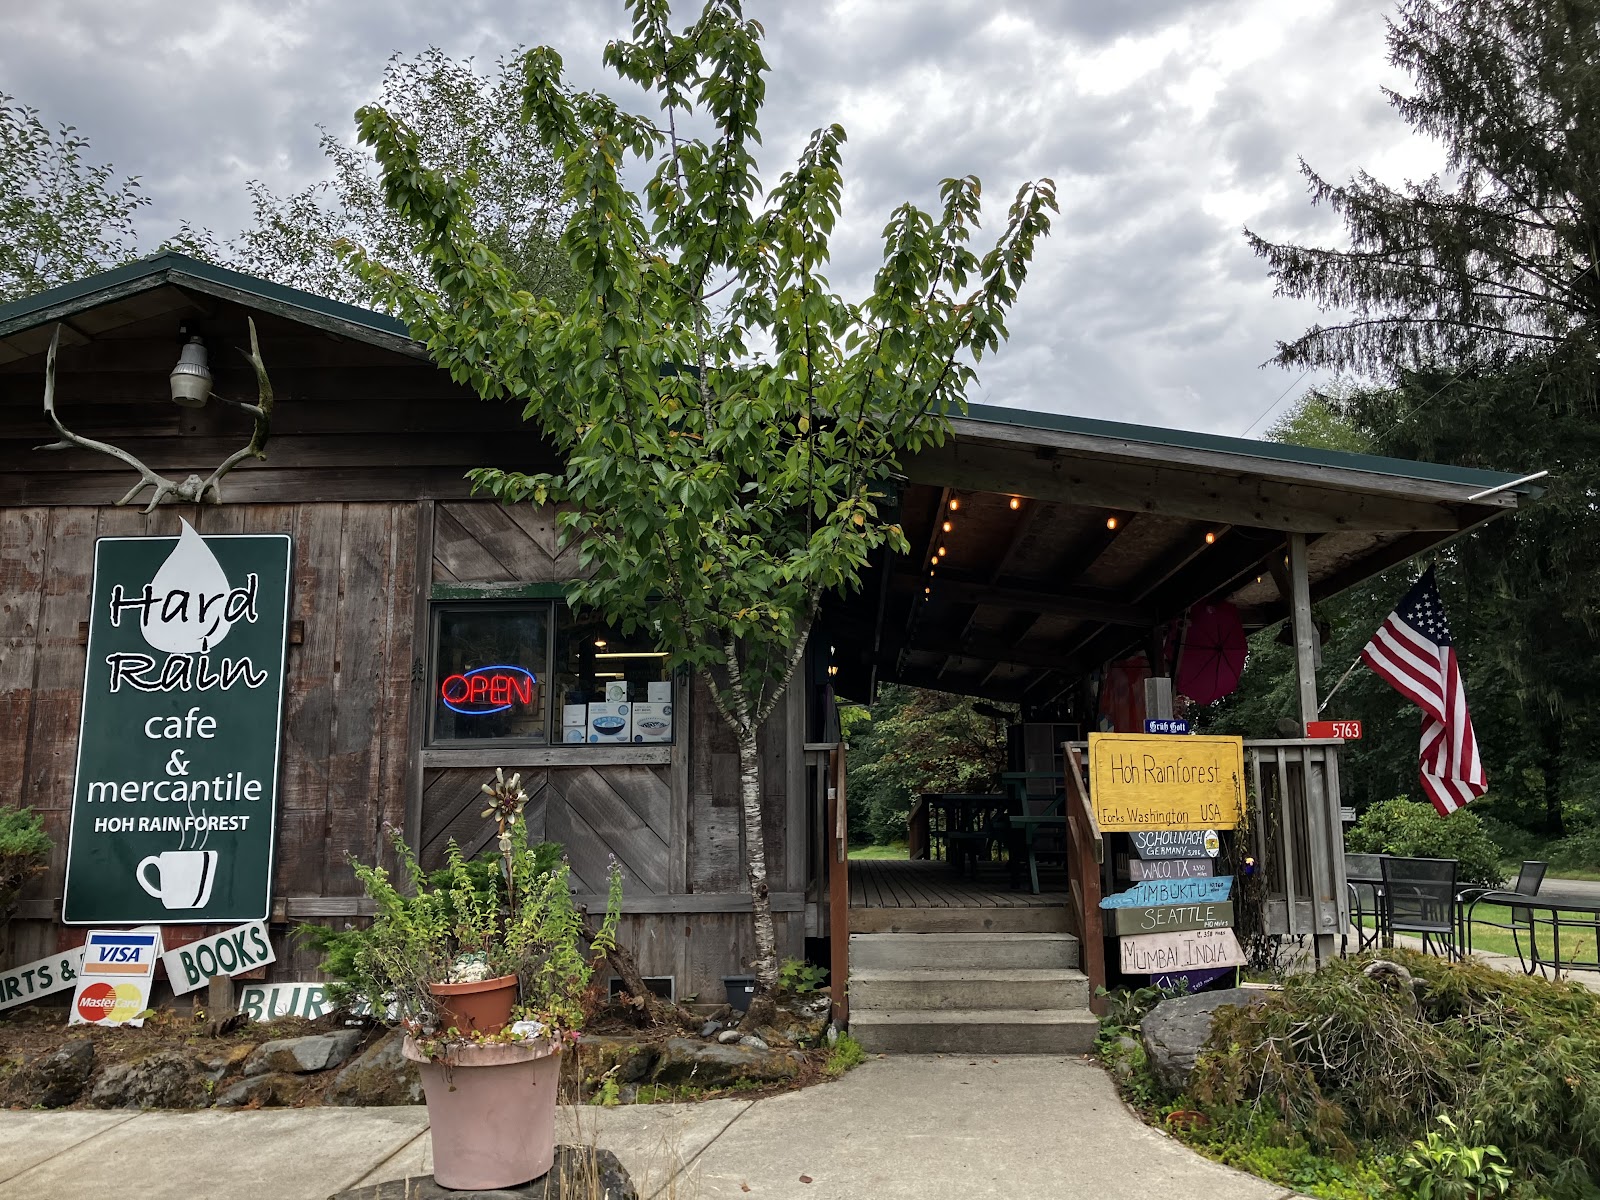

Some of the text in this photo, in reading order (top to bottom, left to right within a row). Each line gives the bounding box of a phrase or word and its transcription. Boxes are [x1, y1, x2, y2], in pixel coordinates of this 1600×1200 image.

[110, 573, 258, 627] Hard
[106, 634, 268, 693] Rain
[442, 674, 532, 704] OPEN
[144, 706, 217, 739] cafe
[1332, 723, 1359, 738] 5763
[165, 749, 190, 776] &
[1111, 753, 1222, 784] Hoh Rainforest
[87, 772, 262, 802] mercantile
[94, 815, 250, 832] HOH RAIN FOREST
[1102, 803, 1222, 826] Forks Washington USA
[1146, 846, 1187, 856] GERMANY
[1173, 860, 1190, 877] TX
[1132, 883, 1207, 903] TIMBUKTU
[1141, 906, 1217, 930] SEATTLE
[99, 946, 141, 962] VISA
[180, 926, 269, 986] BOOKS
[60, 959, 77, 982] &
[79, 997, 139, 1008] MasterCard
